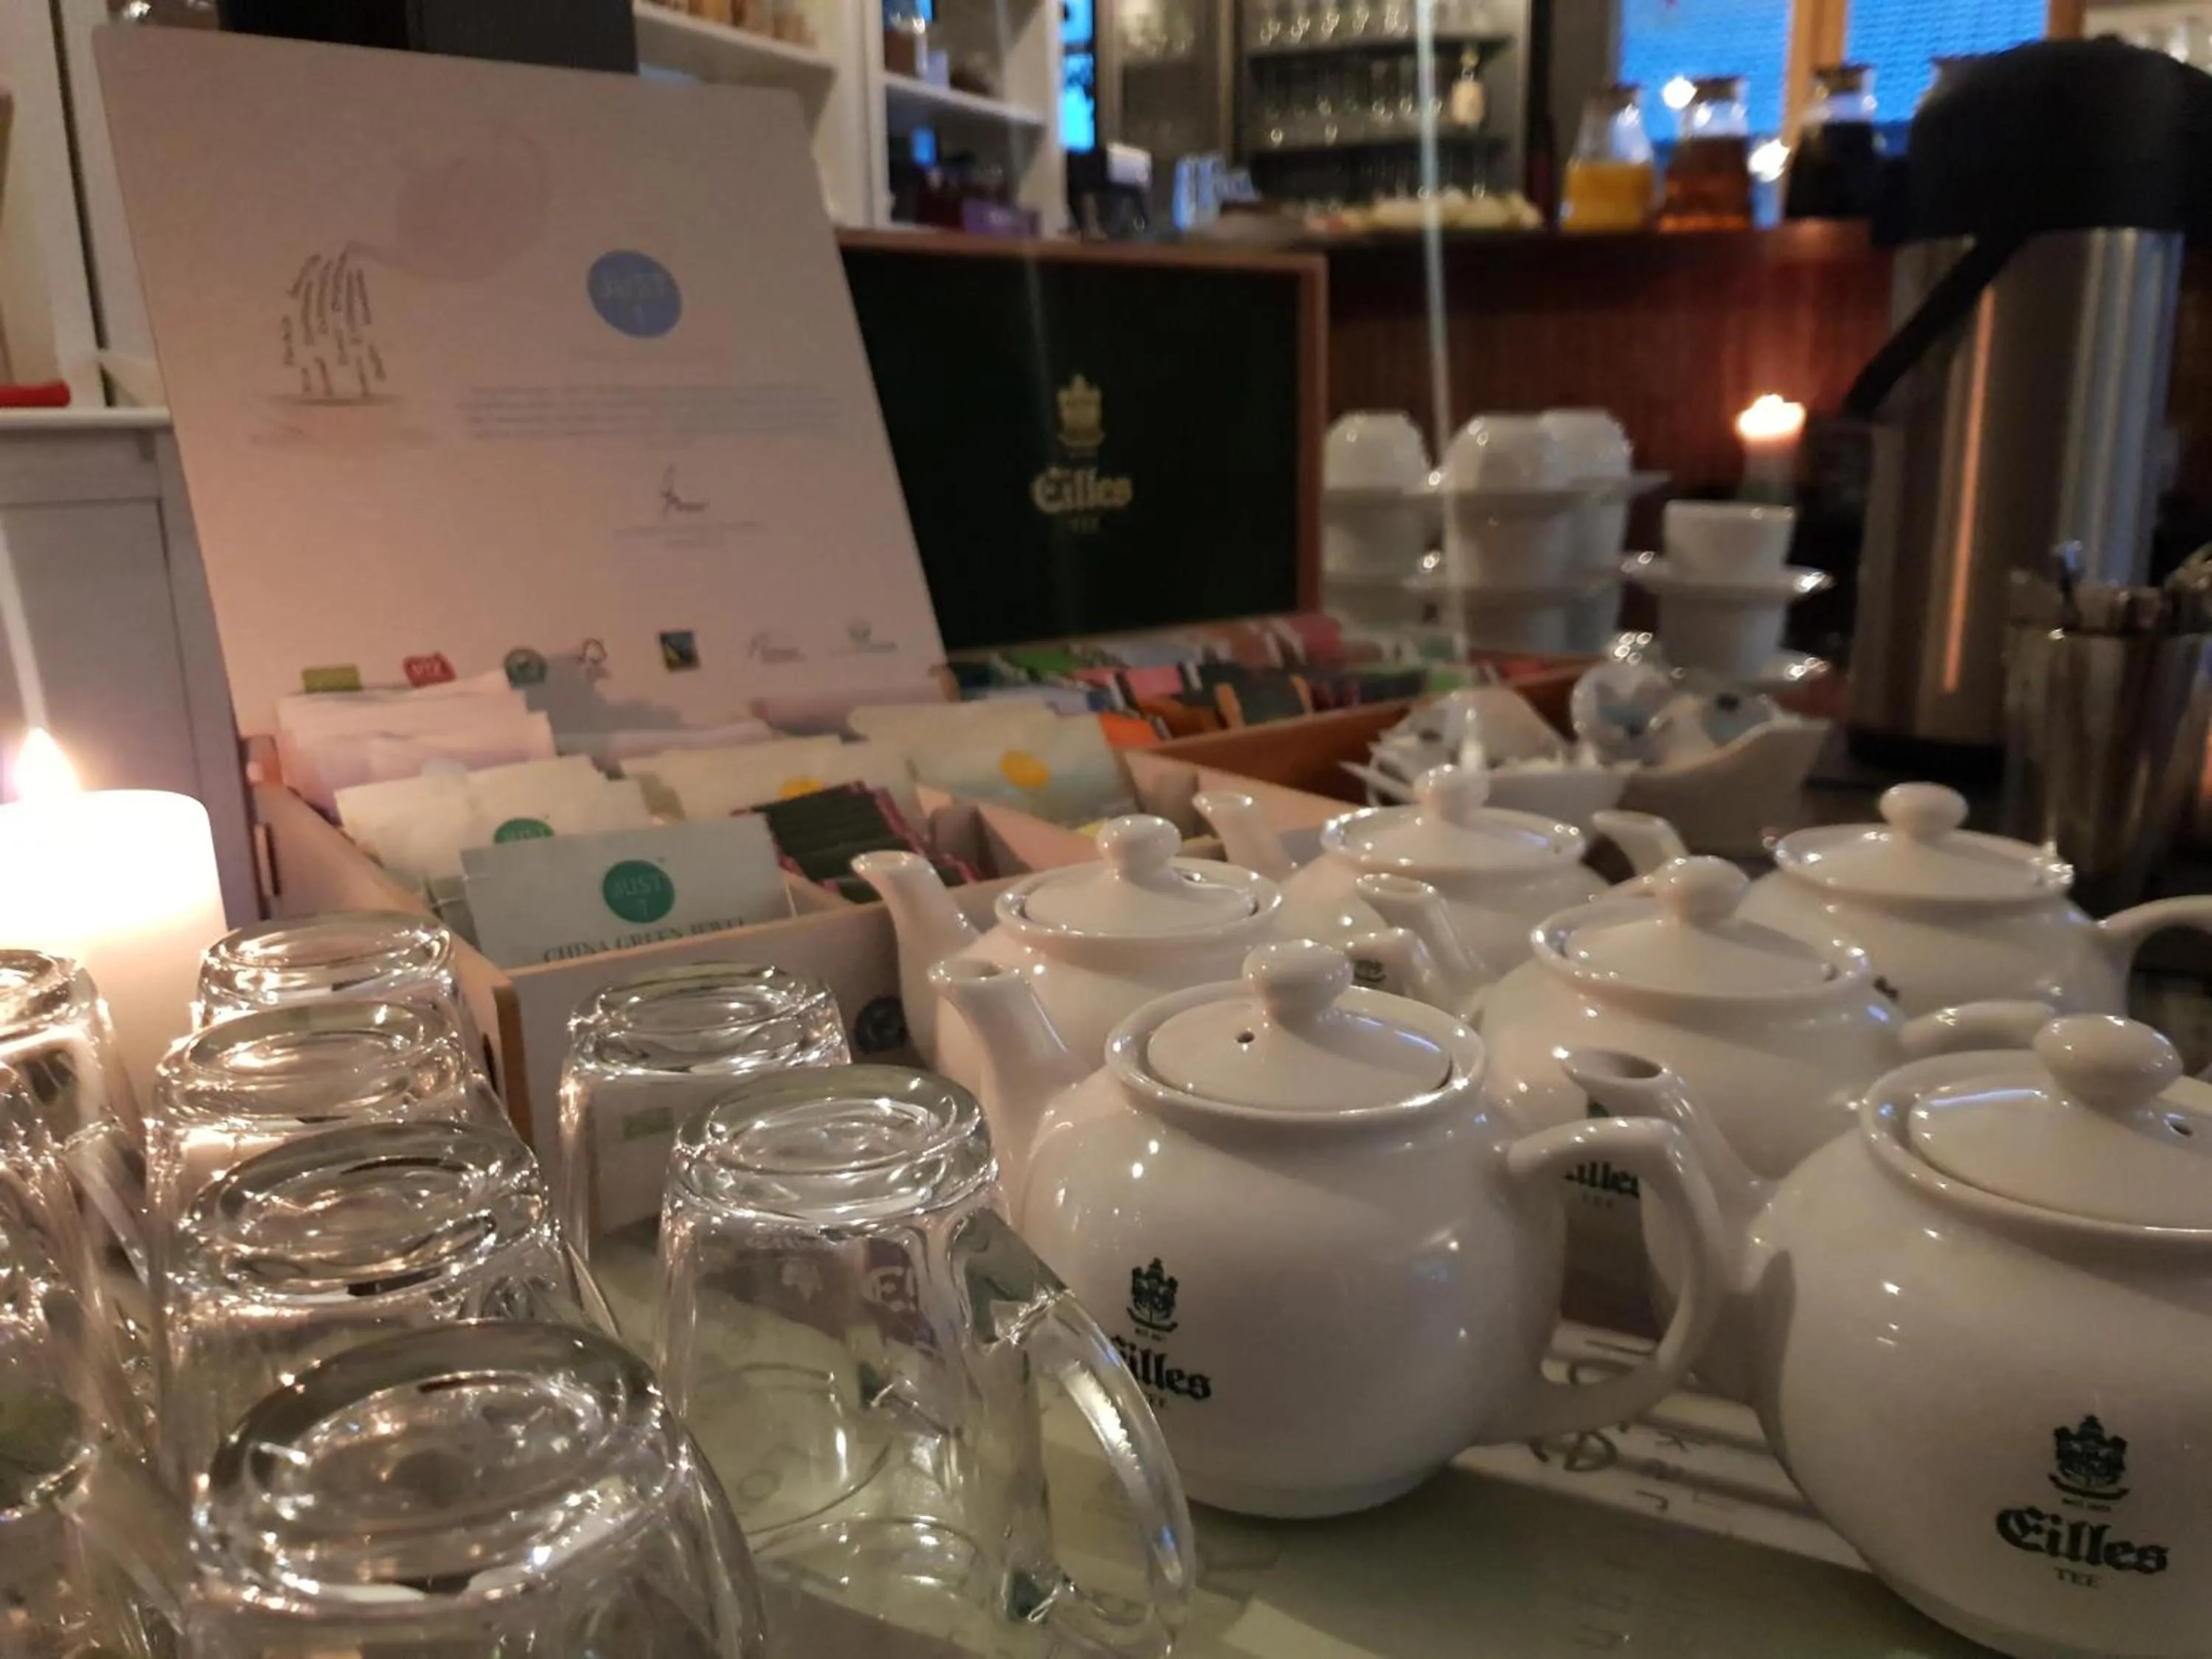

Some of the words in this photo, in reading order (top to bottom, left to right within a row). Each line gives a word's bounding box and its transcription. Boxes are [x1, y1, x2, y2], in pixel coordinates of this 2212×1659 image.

[1031, 465, 1133, 513] Eilles
[611, 873, 663, 899] JUST
[543, 939, 611, 963] CHINA
[1110, 1334, 1212, 1400] illes
[1995, 1506, 2169, 1574] Eilles
